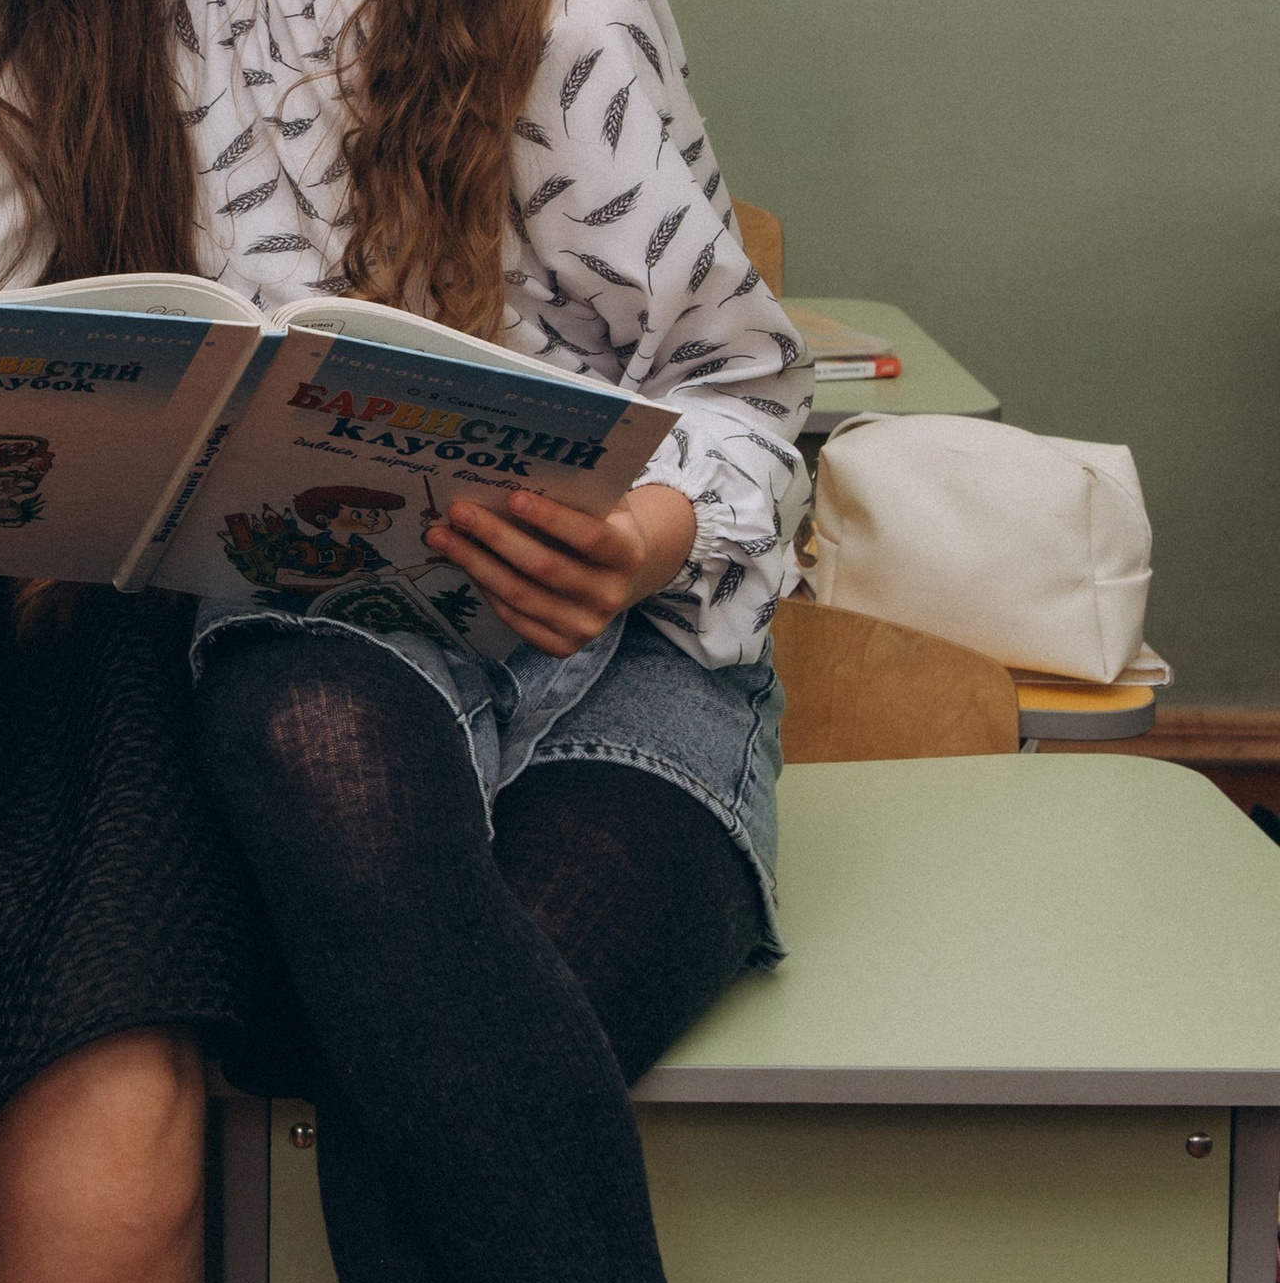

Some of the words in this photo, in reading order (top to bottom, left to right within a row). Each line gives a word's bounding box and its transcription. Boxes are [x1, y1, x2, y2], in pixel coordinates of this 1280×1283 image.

[329, 352, 455, 388] Навчання
[447, 396, 518, 418] Савченко
[286, 381, 608, 470] БАРВИСТИЙ
